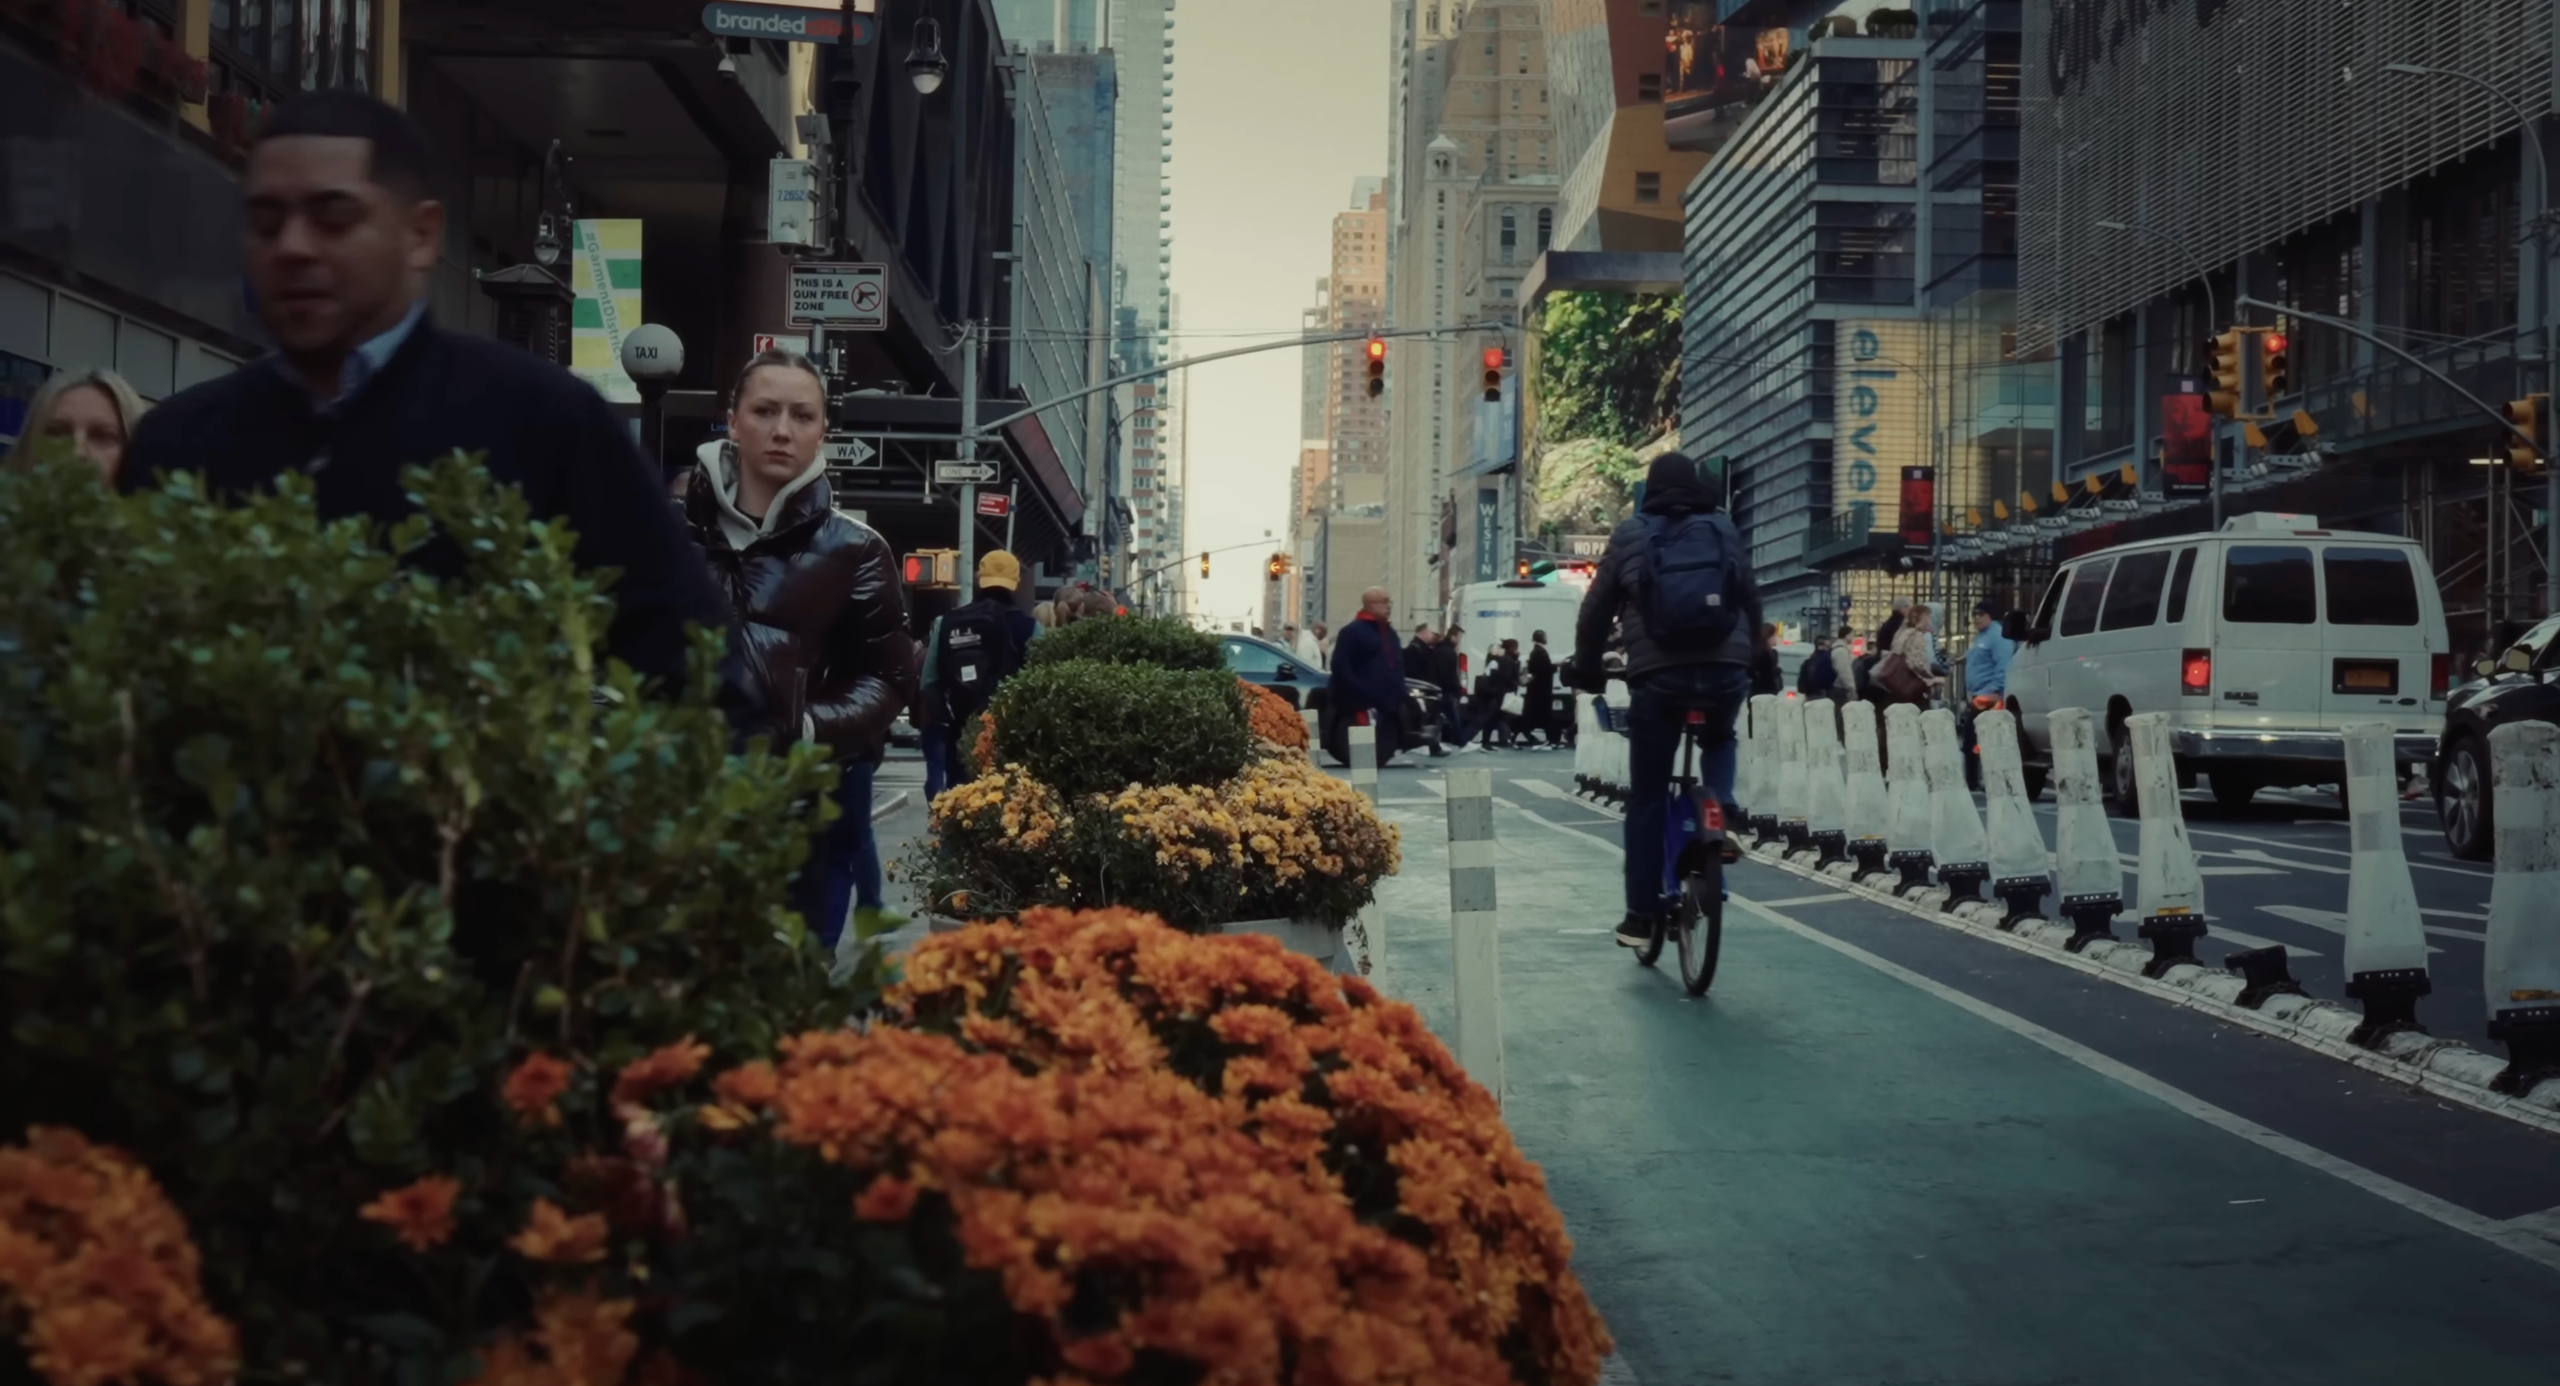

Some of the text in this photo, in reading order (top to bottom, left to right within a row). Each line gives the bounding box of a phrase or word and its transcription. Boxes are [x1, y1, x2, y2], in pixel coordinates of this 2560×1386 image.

[794, 278, 844, 288] THIS IS A
[585, 232, 621, 360] #GarmentDistrict
[793, 290, 849, 300] GUN FREE
[794, 302, 825, 311] ZONE
[635, 346, 658, 359] TAXI
[837, 445, 866, 458] WAY
[971, 467, 989, 476] WAY
[1479, 503, 1496, 575] WESTIN
